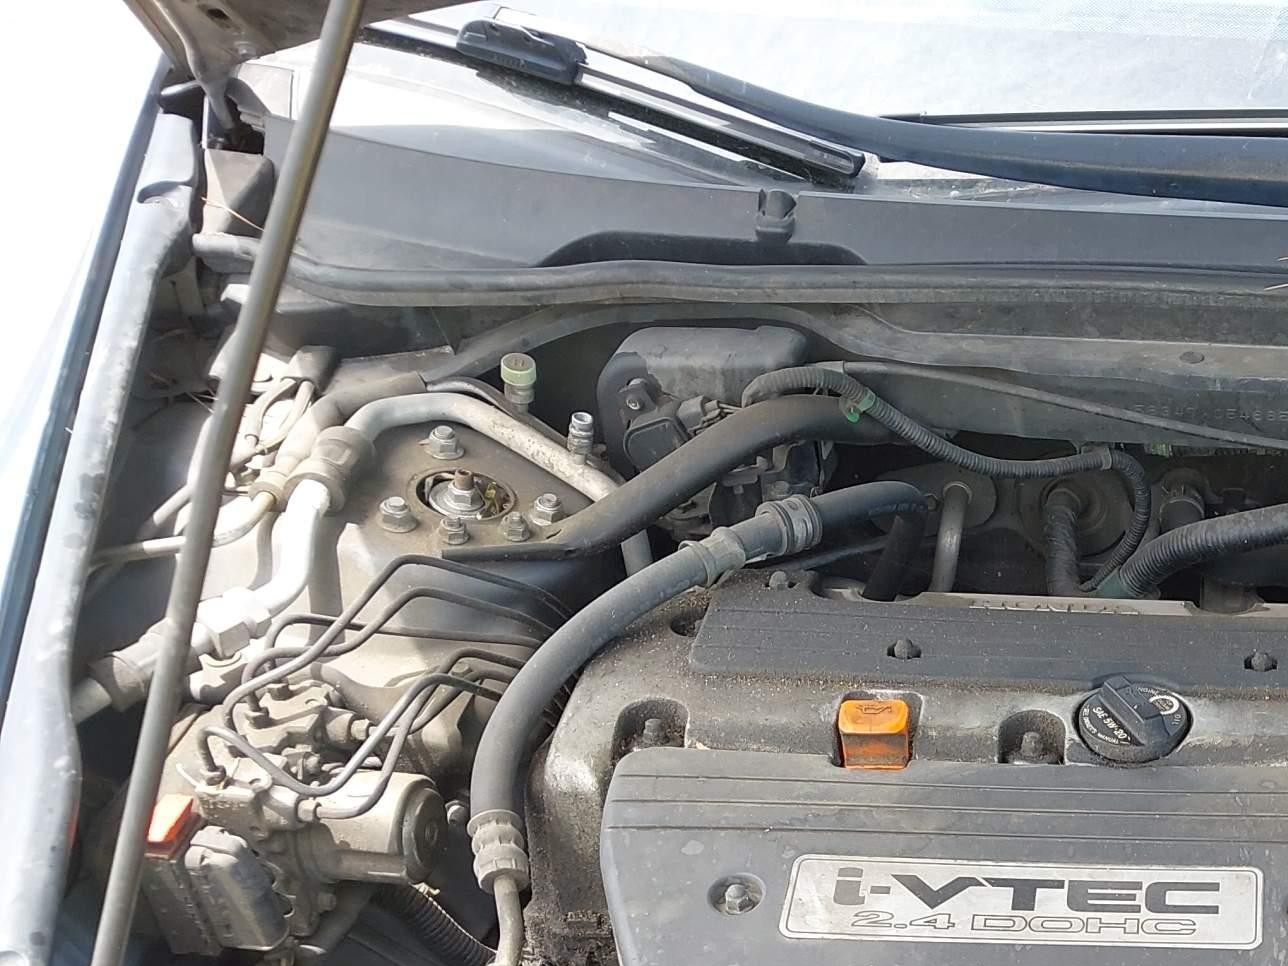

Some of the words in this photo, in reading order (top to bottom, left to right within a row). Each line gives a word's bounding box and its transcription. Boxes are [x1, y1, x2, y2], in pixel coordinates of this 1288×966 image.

[1092, 706, 1109, 719] SAE
[1103, 717, 1128, 739] 5W-20
[832, 866, 1221, 915] i-VTEC
[850, 910, 956, 929] 2.4
[971, 913, 1198, 936] DOHC
